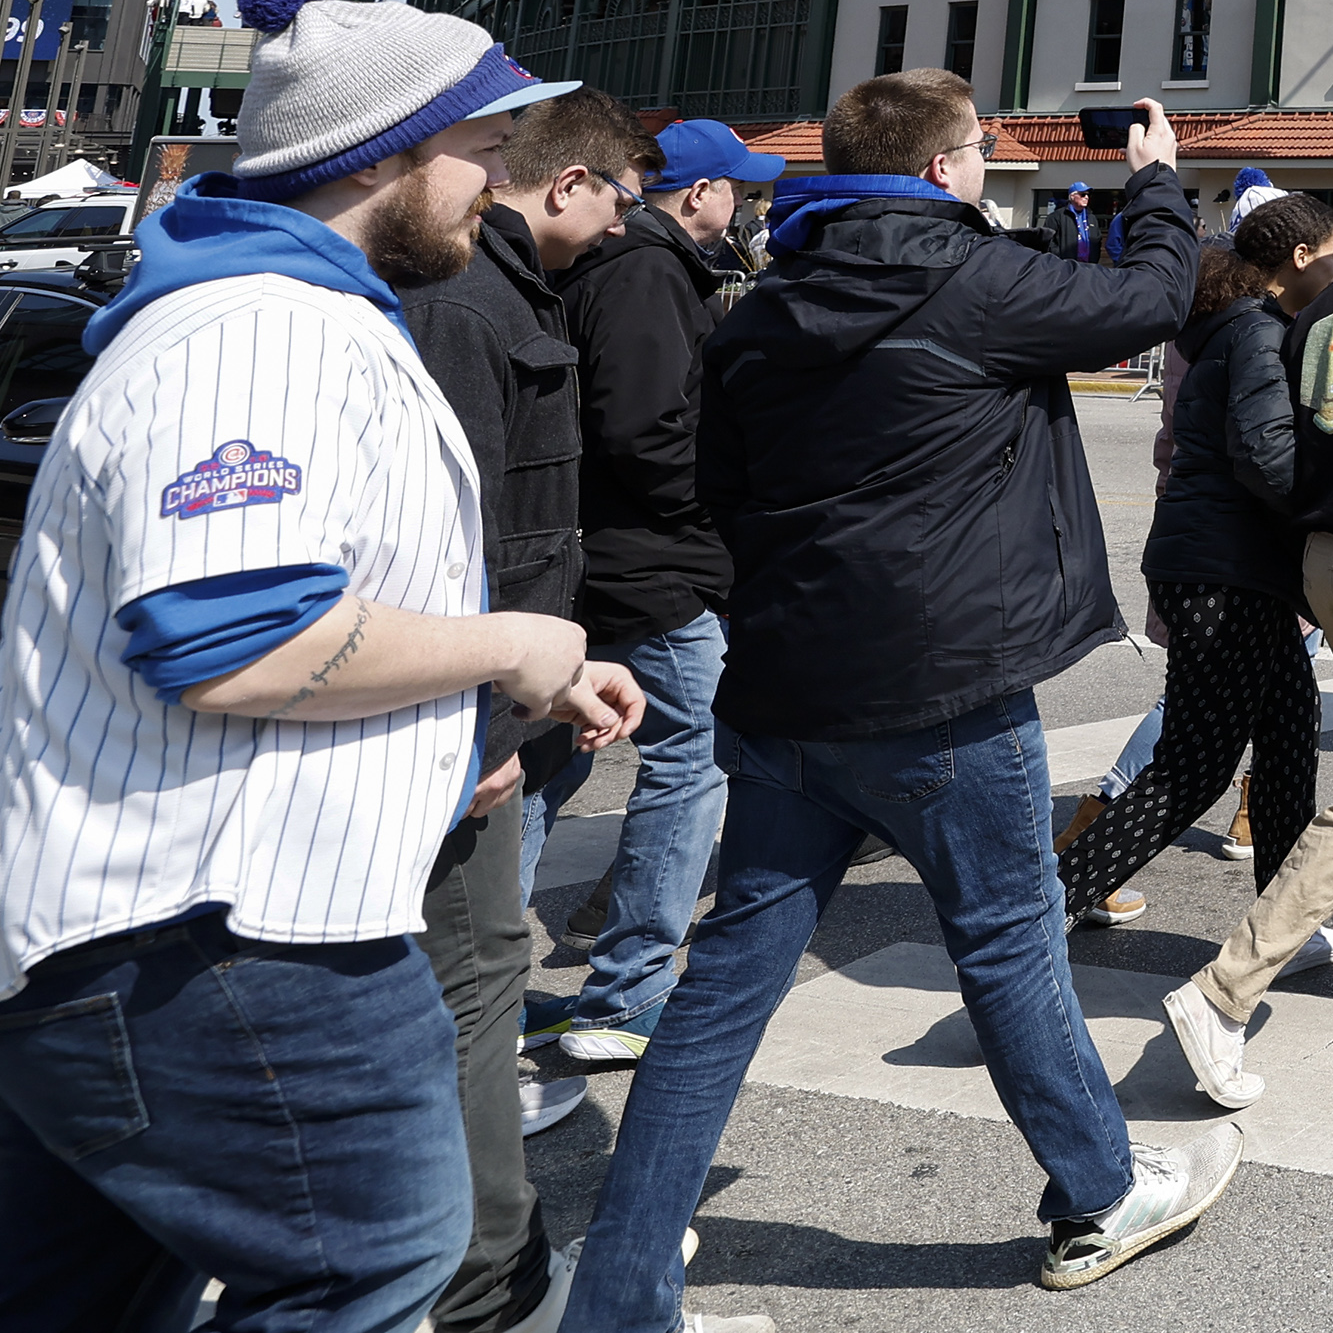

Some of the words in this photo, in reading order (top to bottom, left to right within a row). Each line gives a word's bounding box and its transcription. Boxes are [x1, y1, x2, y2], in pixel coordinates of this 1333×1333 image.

[182, 467, 230, 484] WORLD
[234, 460, 285, 473] SERIES
[165, 468, 297, 510] CHAMPIONS
